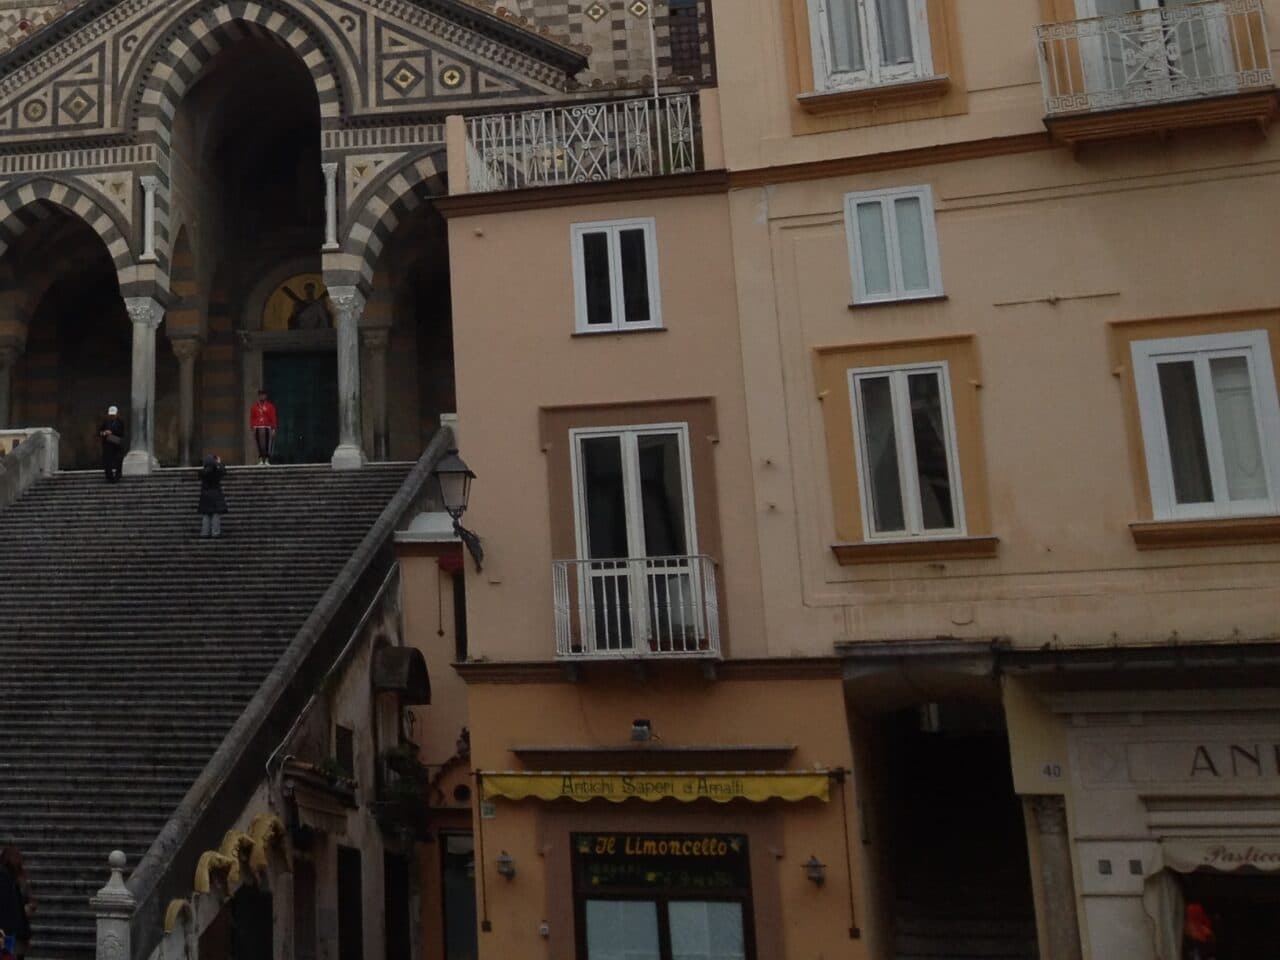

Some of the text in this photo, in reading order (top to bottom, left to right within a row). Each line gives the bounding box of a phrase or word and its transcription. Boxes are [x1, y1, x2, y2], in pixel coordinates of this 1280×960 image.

[1042, 763, 1062, 778] 40
[560, 776, 615, 794] Antichi
[621, 775, 675, 797] Sapori
[625, 836, 728, 856] Limoncello
